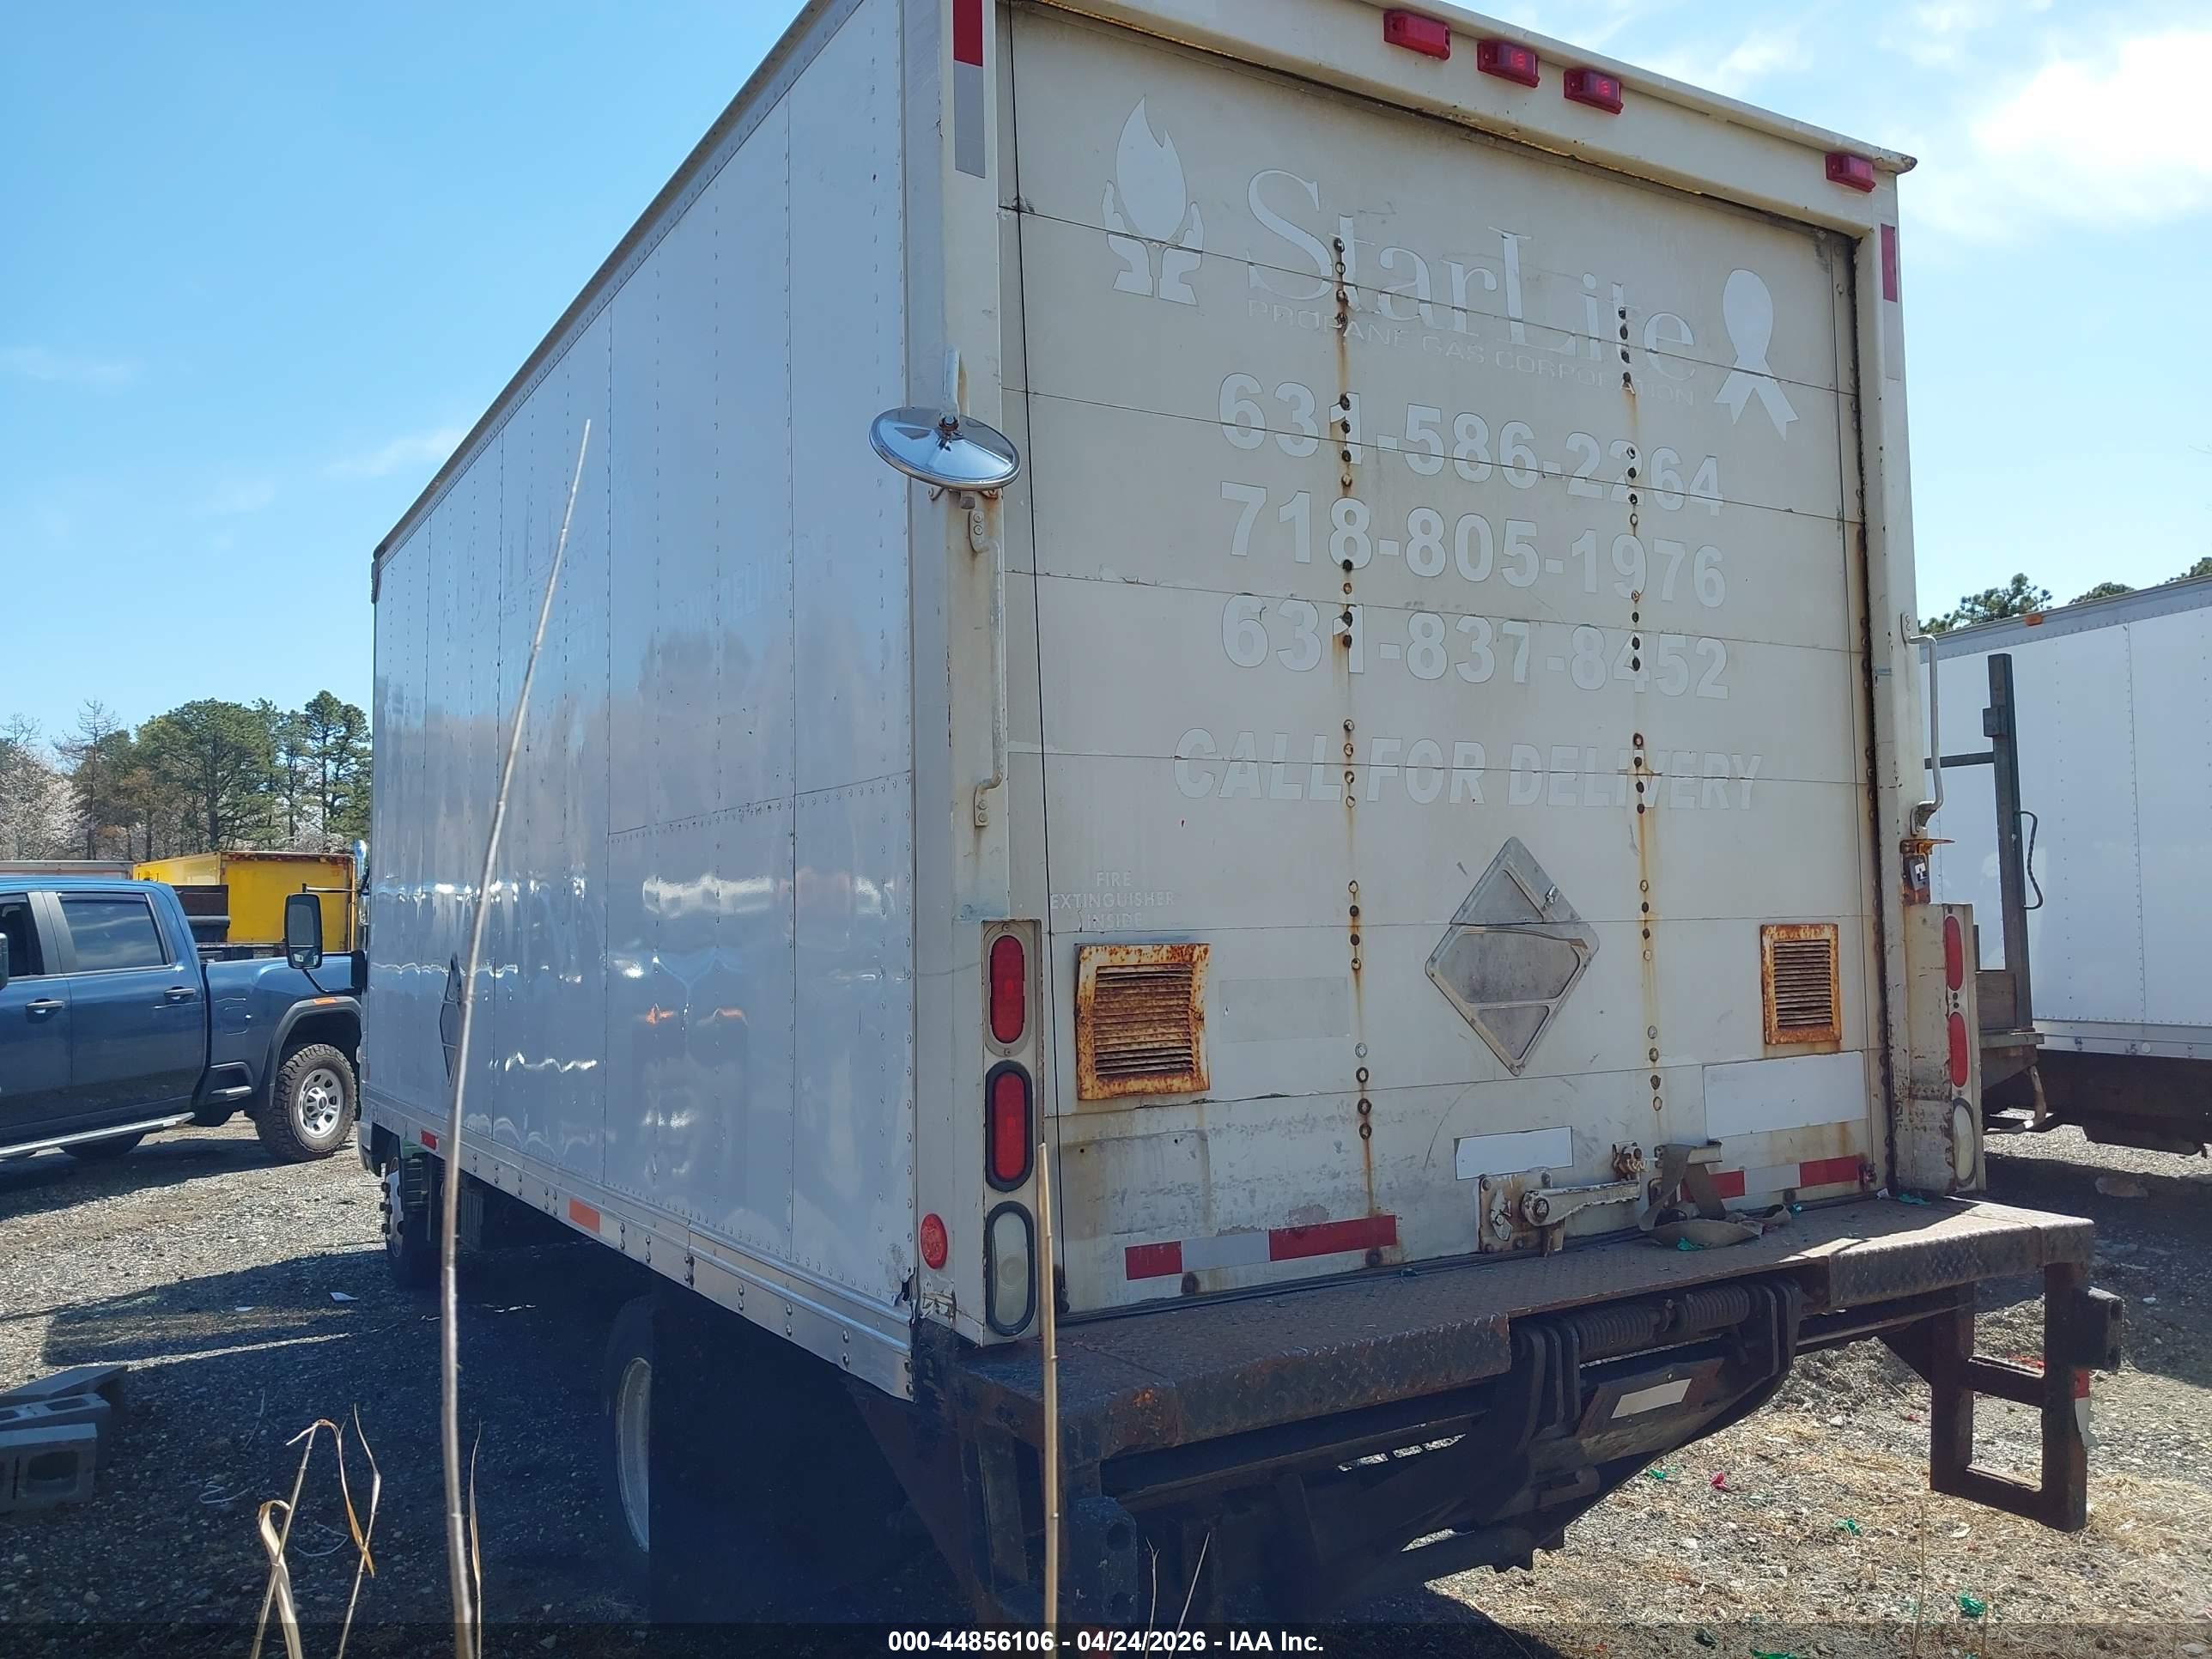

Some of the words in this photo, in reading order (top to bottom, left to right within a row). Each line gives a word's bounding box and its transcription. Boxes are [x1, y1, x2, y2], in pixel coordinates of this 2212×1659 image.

[1247, 168, 1696, 383] StarLite
[1248, 299, 1411, 350] PROPANE
[1421, 336, 1486, 365] GAS
[1218, 372, 1724, 516] 631-586-2264
[1219, 480, 1727, 608] 718-805-1976
[1220, 592, 1730, 700] 631-837-8452
[1173, 728, 1344, 802] CALL
[1365, 735, 1488, 806] FOR
[1507, 742, 1764, 811] DELIVERY
[1049, 890, 1176, 910] EXTINGUISHER
[1086, 912, 1144, 929] INSIDE
[1095, 871, 1133, 887] FIRE
